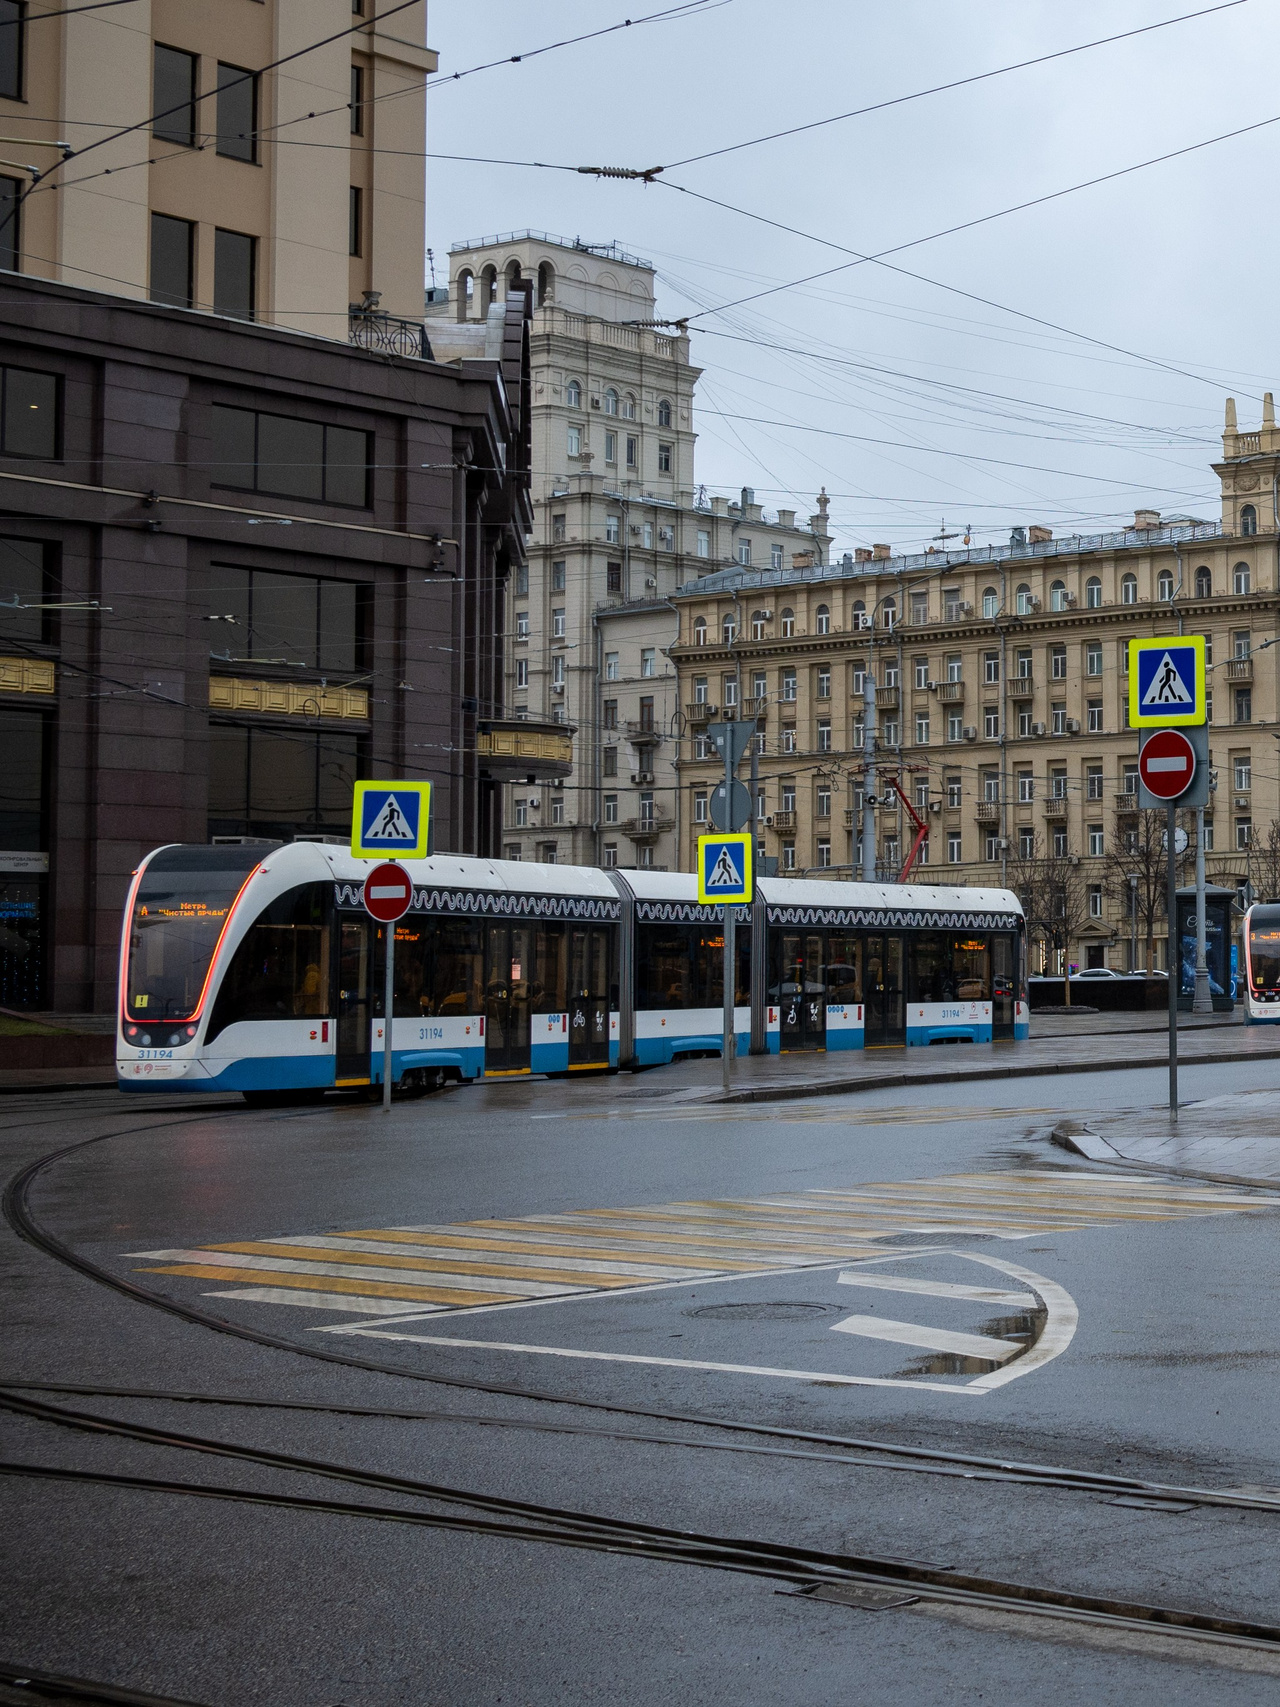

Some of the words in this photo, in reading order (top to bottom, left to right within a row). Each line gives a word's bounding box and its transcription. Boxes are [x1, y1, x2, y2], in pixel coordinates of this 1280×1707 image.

[141, 905, 149, 916] А
[180, 902, 207, 910] Метро
[941, 1009, 960, 1019] 31194
[419, 1027, 443, 1040] 31194
[138, 1049, 173, 1059] 31194
